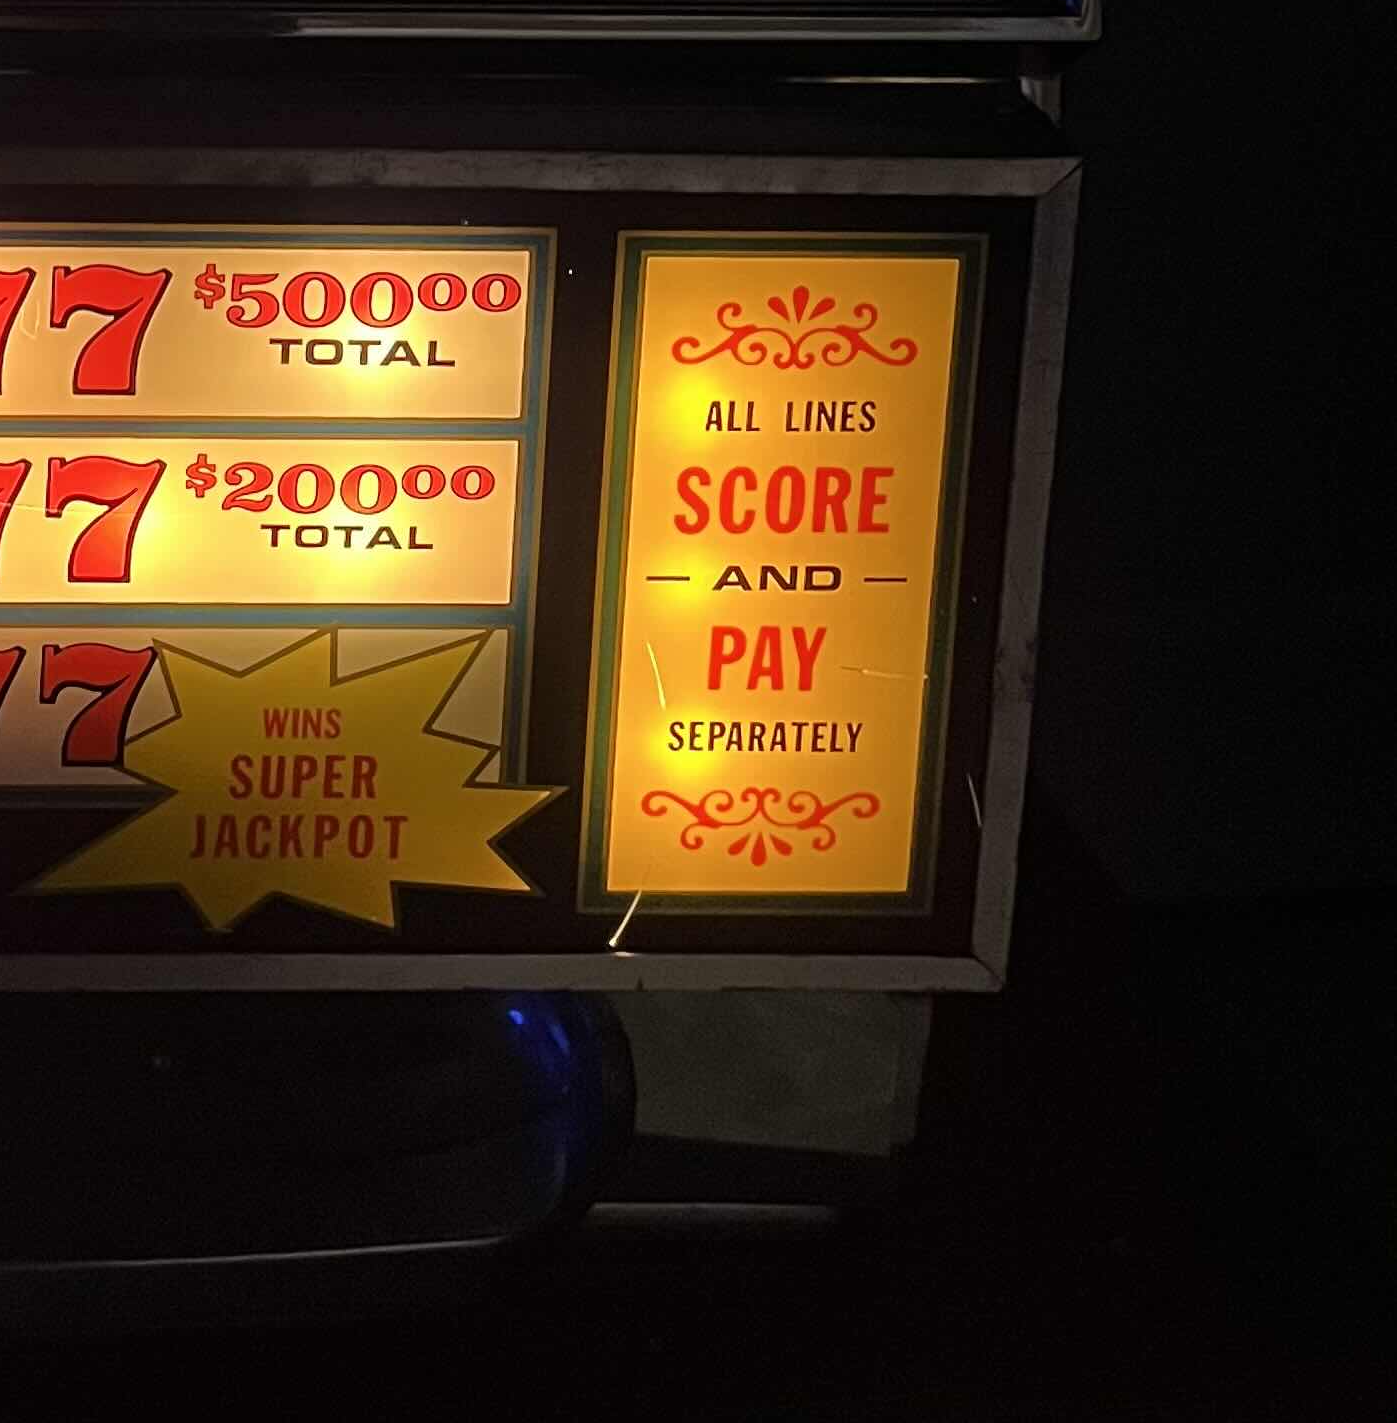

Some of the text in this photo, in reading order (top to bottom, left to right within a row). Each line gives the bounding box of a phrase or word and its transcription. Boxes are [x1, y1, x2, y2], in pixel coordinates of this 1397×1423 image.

[269, 337, 456, 368] TOTAL
[705, 400, 878, 433] ALL LINES
[673, 465, 896, 536] SCORE
[260, 523, 434, 550] TOTAL
[711, 565, 843, 592] AND
[706, 625, 828, 692] PAY
[263, 708, 342, 739] WINS
[666, 721, 864, 753] SEPARATELY
[228, 754, 379, 801] SUPER
[189, 814, 409, 860] JACKPOT
